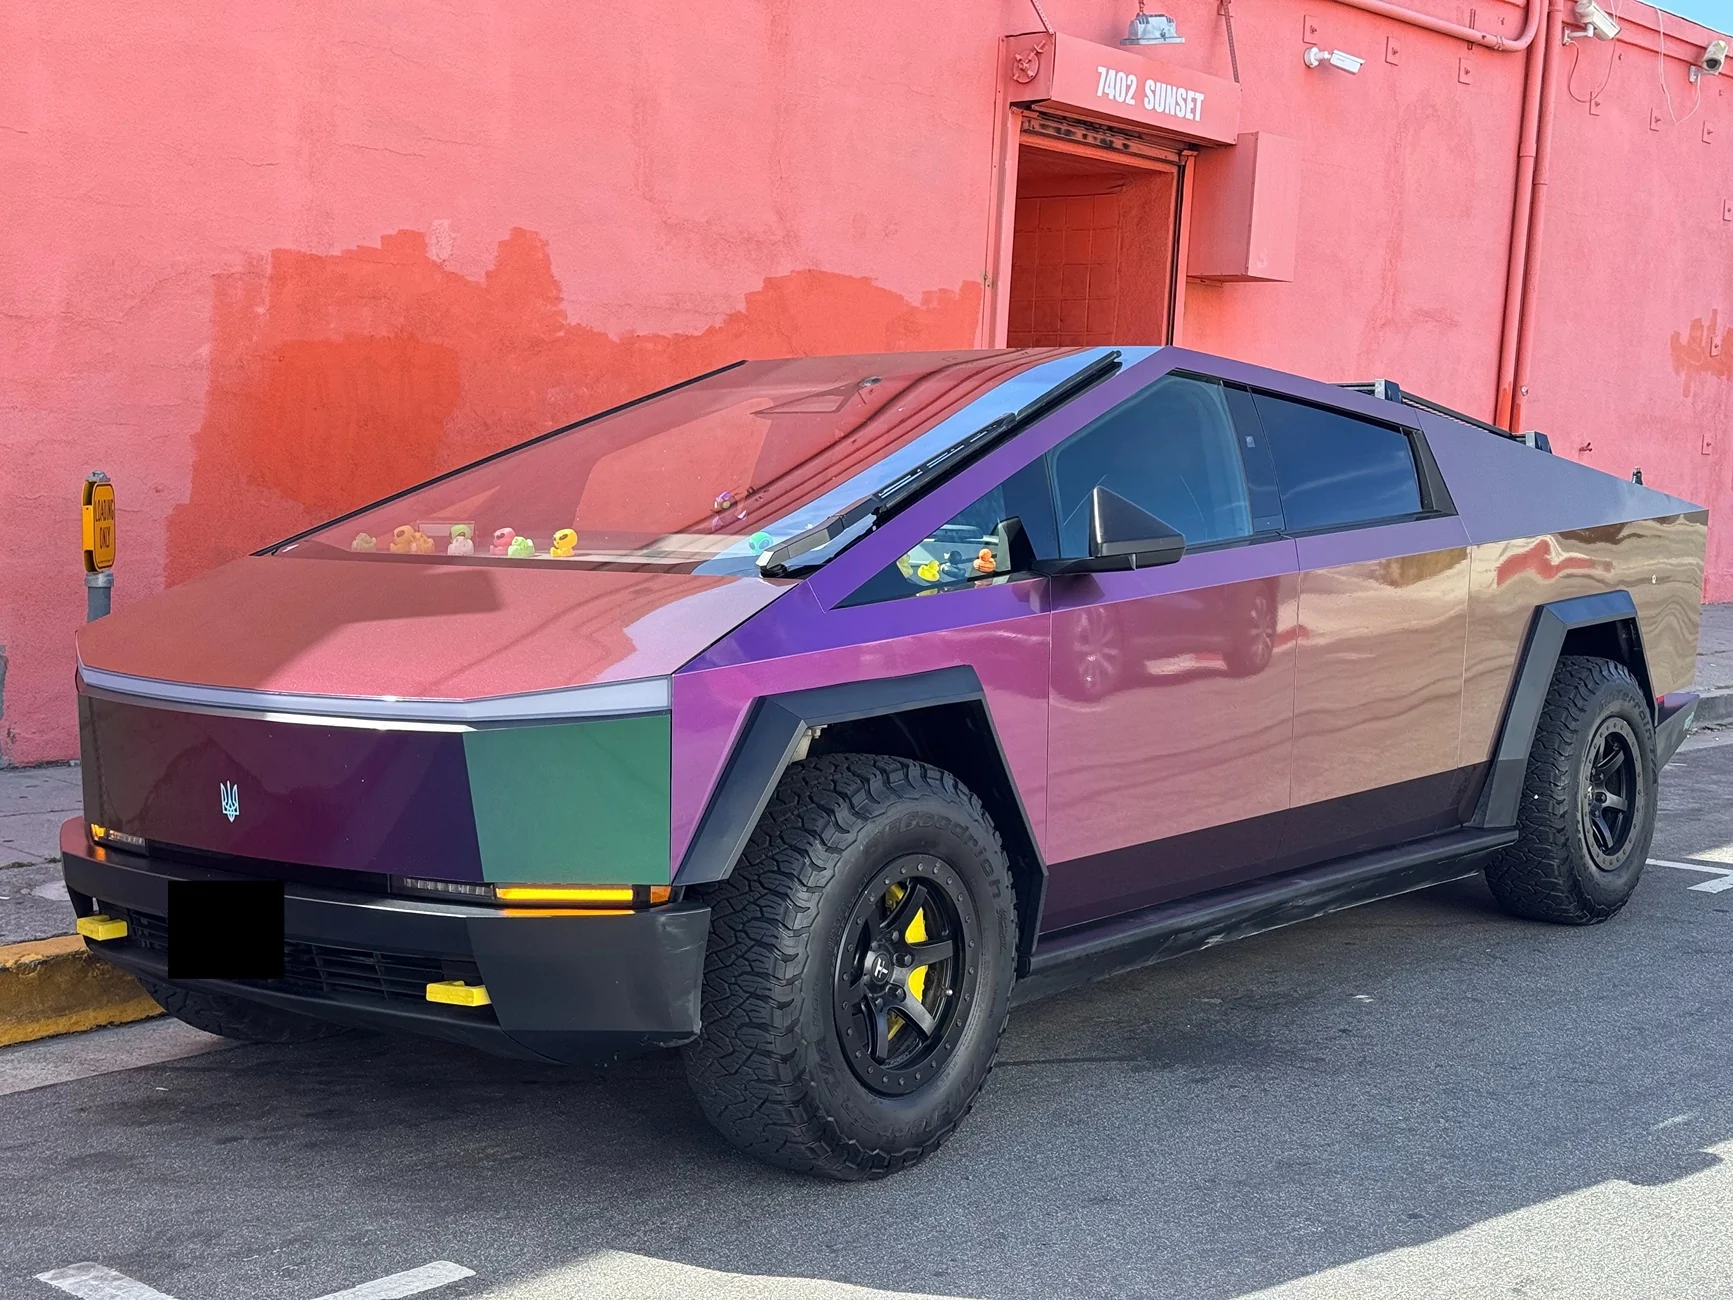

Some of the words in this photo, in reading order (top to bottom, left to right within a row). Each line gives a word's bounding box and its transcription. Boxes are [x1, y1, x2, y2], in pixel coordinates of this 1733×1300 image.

[1096, 65, 1137, 105] 7402
[1143, 79, 1204, 122] SUNSET
[96, 499, 114, 522] LOADING
[99, 526, 111, 549] ONLY
